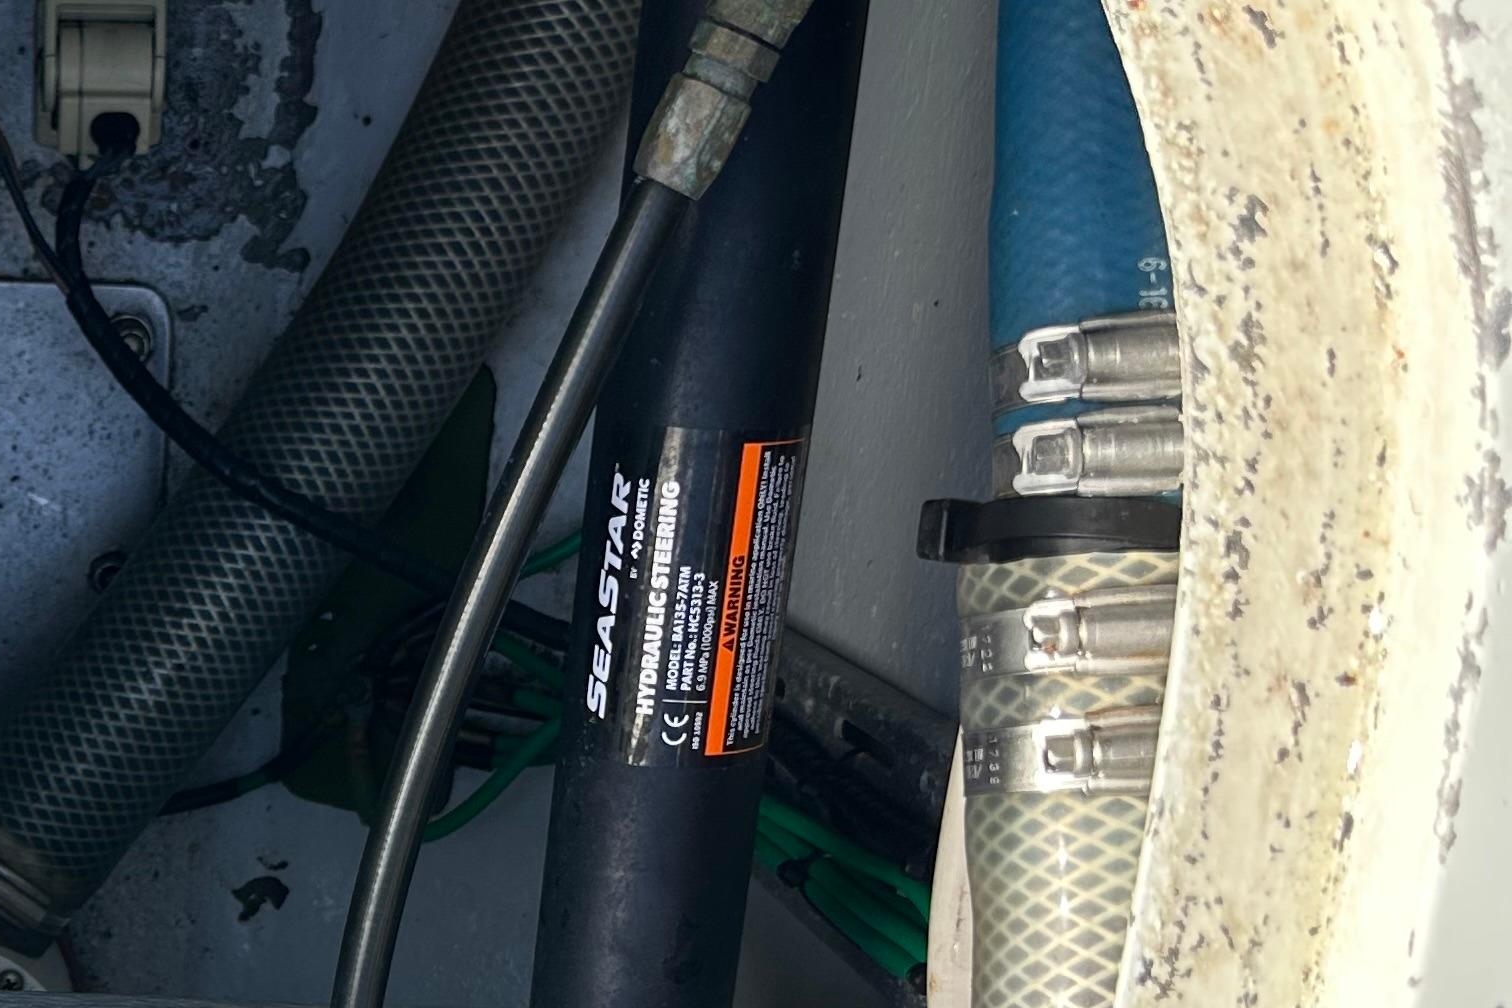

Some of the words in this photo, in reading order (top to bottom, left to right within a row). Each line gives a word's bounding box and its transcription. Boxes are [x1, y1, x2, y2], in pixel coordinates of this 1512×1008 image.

[632, 478, 650, 540] DOMETIC
[650, 481, 680, 589] STEERING
[586, 472, 632, 720] SEASTAR
[671, 566, 692, 641] BA135-7ATM
[706, 580, 719, 605] MAX
[723, 555, 744, 637] WARNING
[635, 591, 667, 715] HYDRAULIC
[665, 644, 682, 690] MODEL:
[680, 661, 694, 690] PART
[687, 573, 706, 632] HC5313-3
[697, 652, 710, 673] MPa
[695, 675, 707, 691] 6.9
